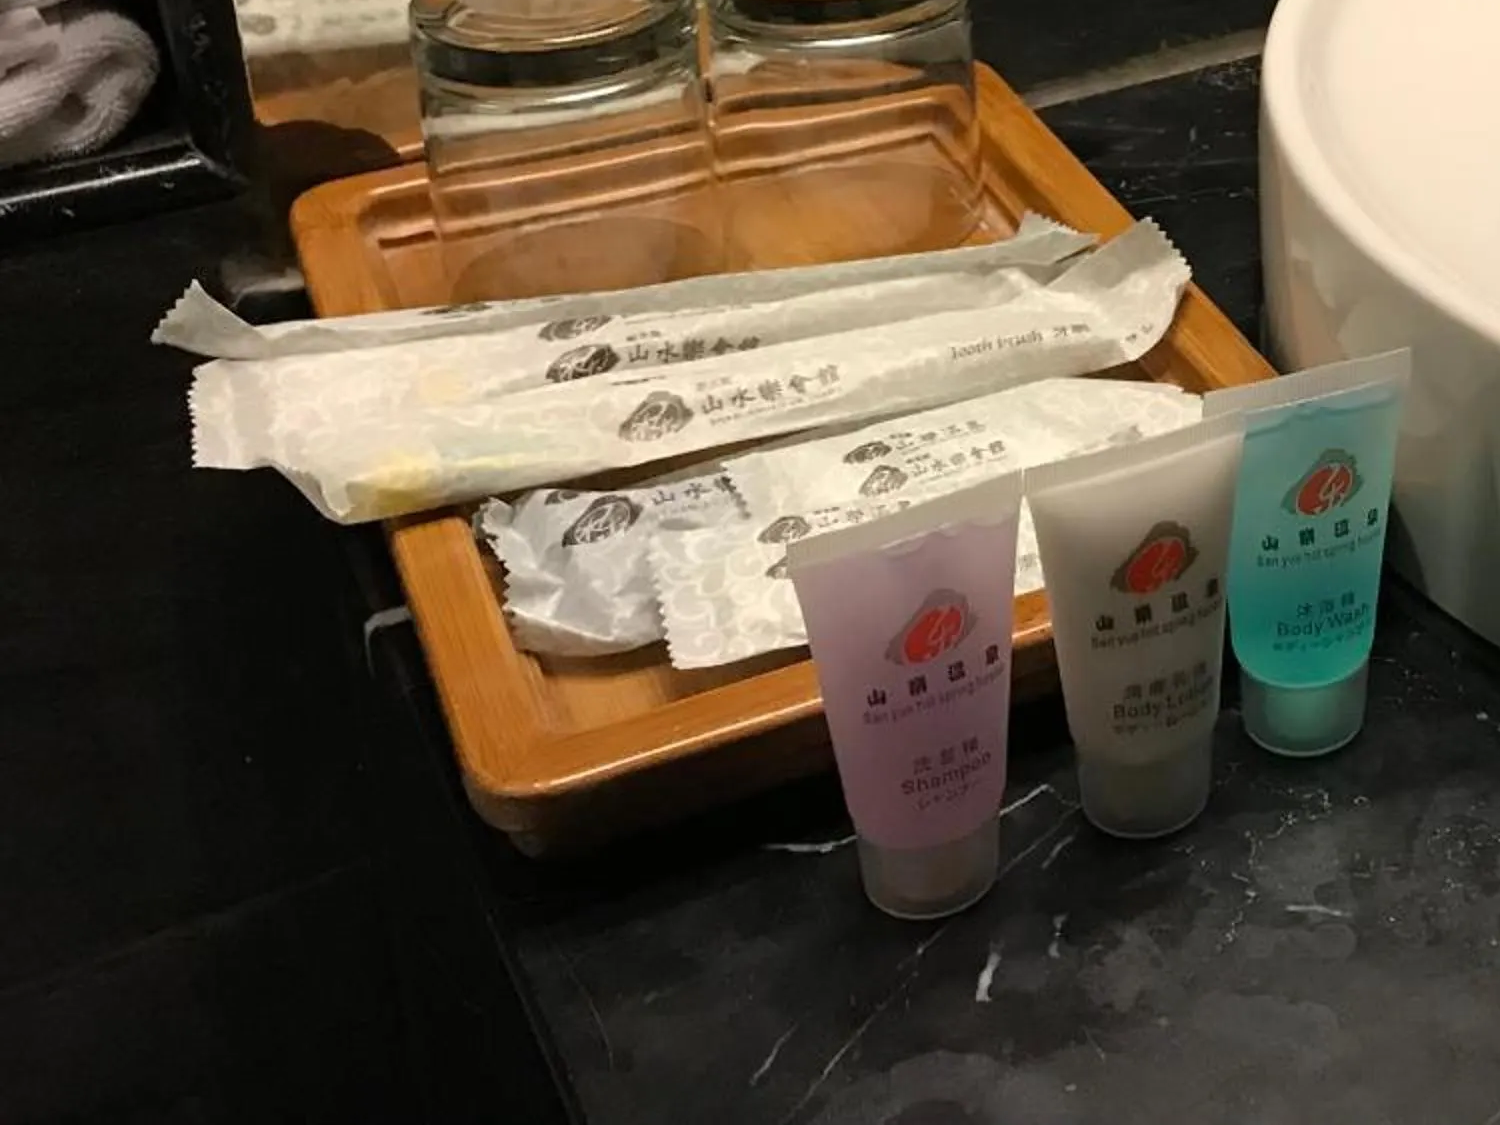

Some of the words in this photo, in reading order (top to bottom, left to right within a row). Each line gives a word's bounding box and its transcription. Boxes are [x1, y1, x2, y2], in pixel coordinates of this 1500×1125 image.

[1276, 618, 1323, 638] Body
[1327, 603, 1370, 630] Wash
[1112, 697, 1161, 720] Body
